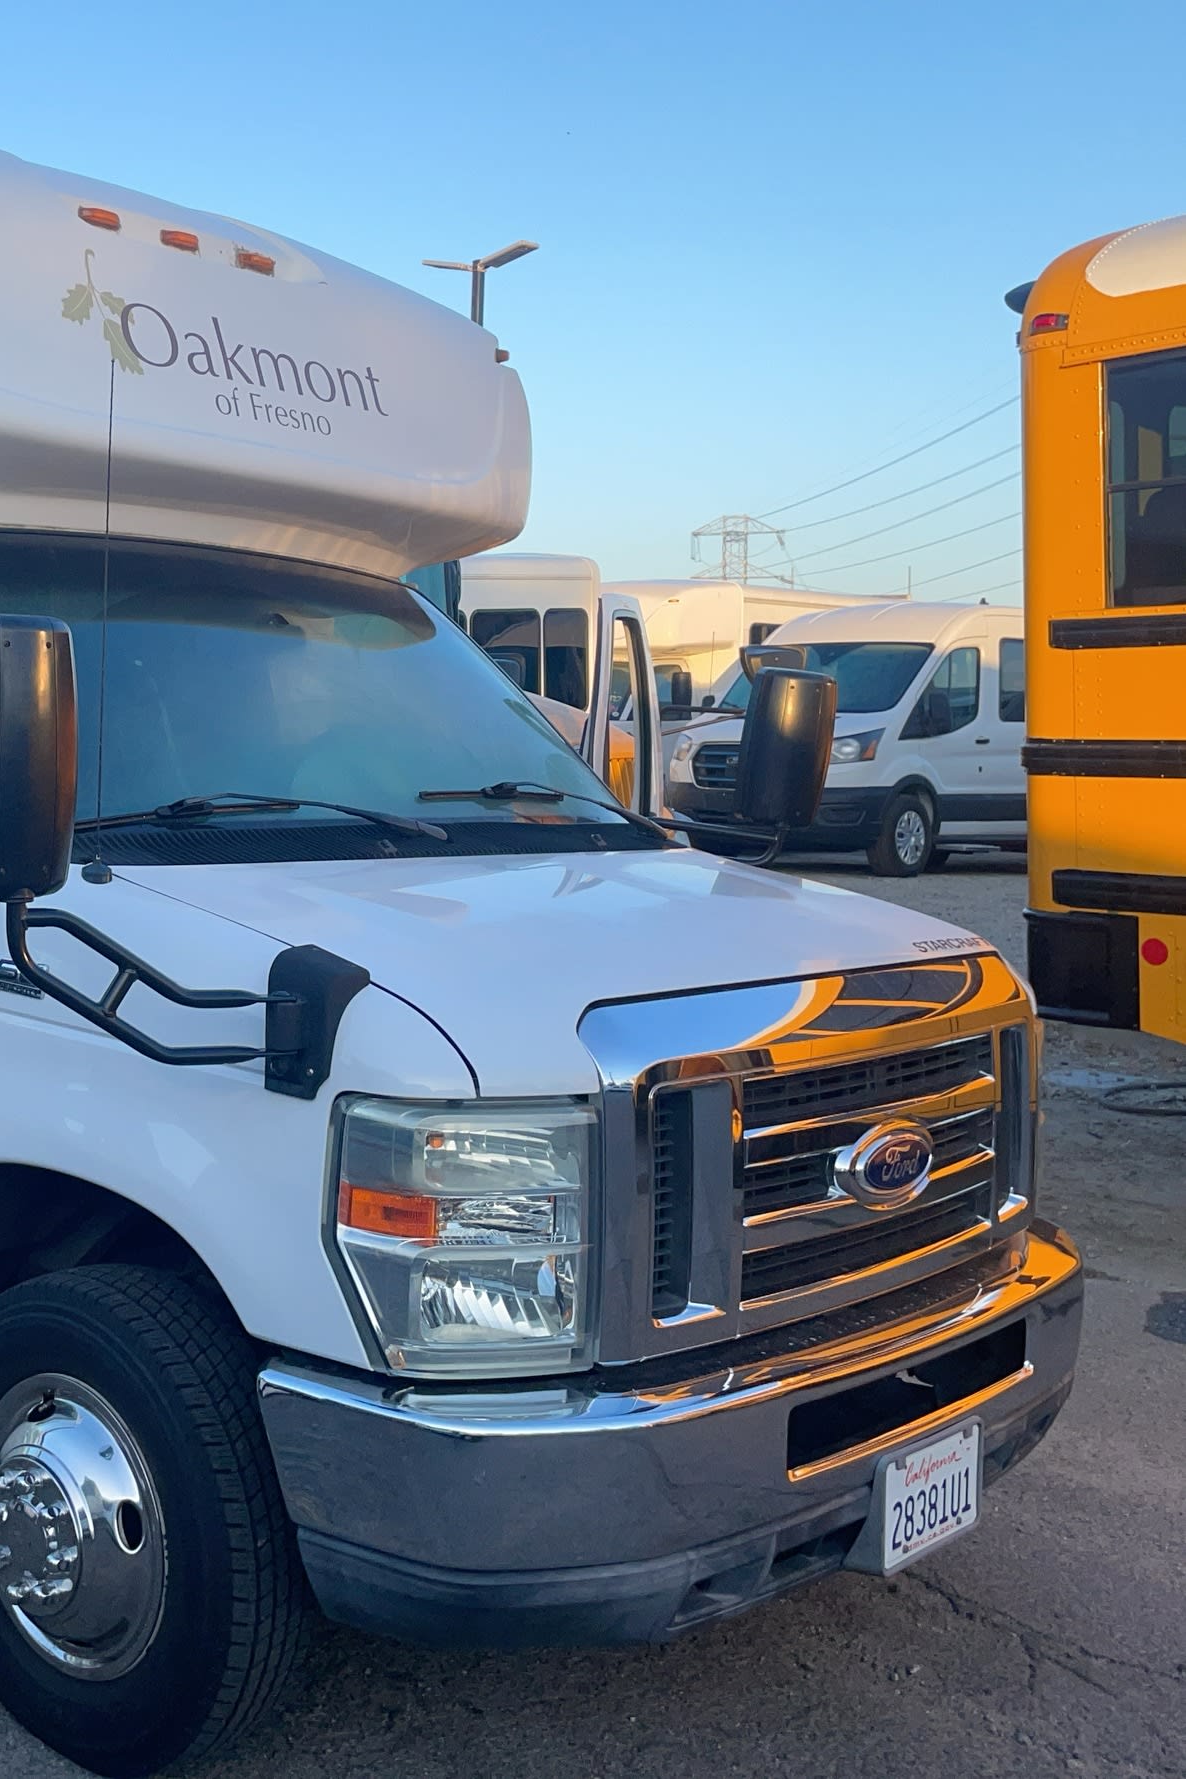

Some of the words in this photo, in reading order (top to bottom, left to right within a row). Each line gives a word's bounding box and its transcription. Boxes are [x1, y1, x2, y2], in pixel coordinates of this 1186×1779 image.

[120, 303, 389, 416] Oakmont
[215, 387, 241, 416] of
[249, 392, 331, 435] Fresno
[912, 937, 990, 953] STARCRAFT
[881, 1144, 920, 1182] Ford
[905, 1451, 961, 1487] California
[892, 1466, 971, 1550] 28381U1
